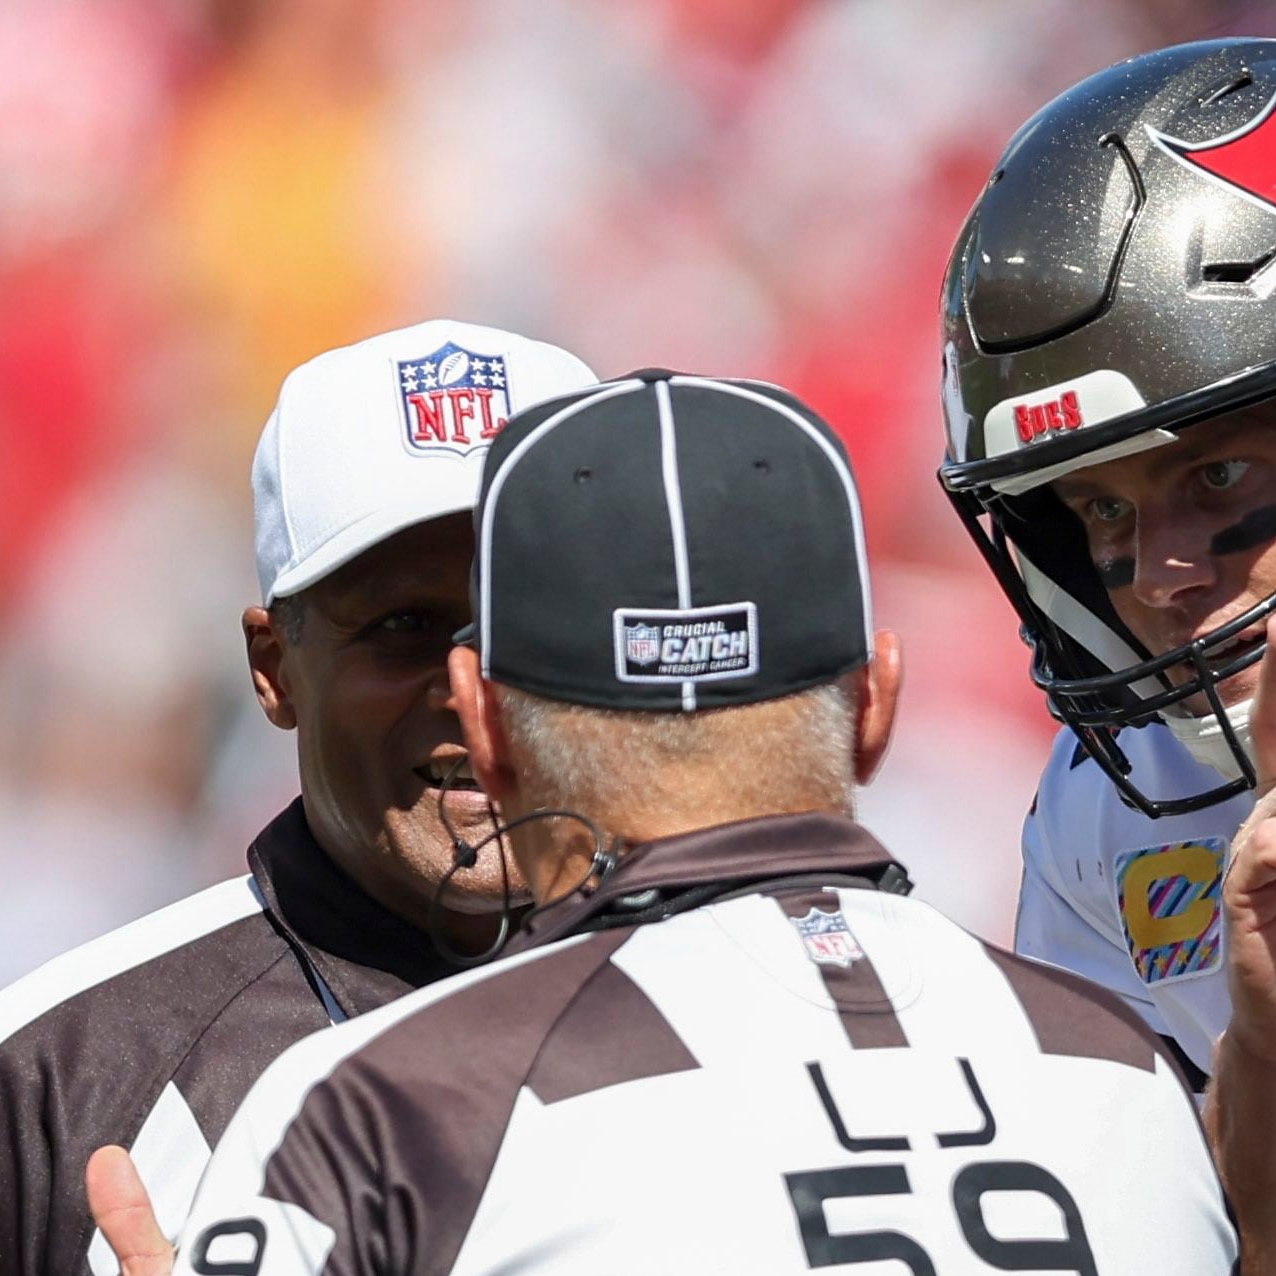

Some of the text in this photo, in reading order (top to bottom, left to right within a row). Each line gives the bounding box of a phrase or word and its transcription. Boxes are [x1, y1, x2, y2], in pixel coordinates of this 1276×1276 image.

[409, 387, 508, 445] NFL
[663, 620, 726, 638] CRUCIAL
[660, 630, 748, 664] CATCH
